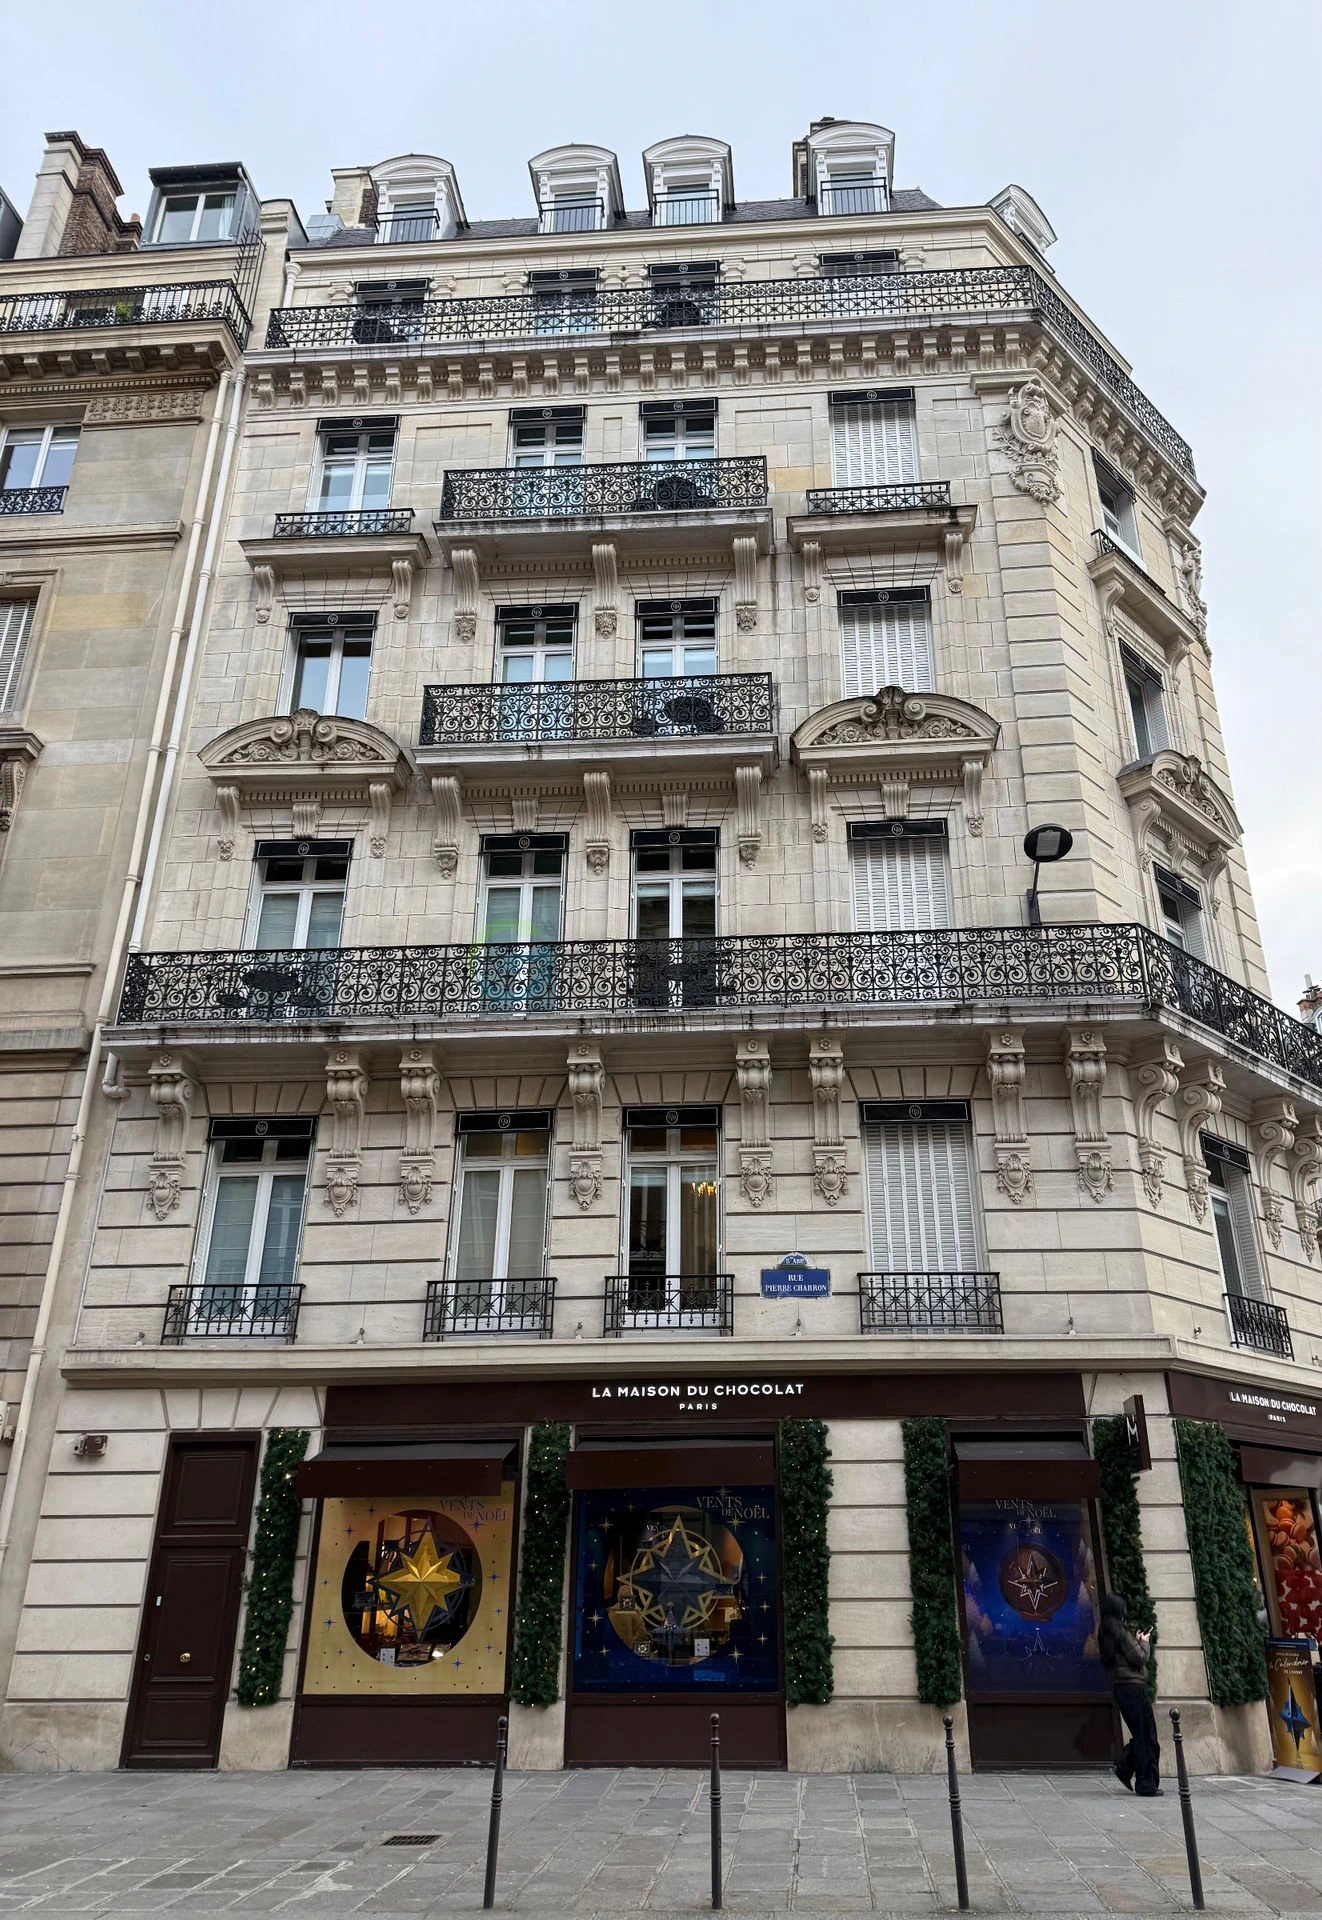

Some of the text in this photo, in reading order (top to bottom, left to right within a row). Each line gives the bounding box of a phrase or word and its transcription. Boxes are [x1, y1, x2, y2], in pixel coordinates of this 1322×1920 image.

[765, 1284, 827, 1292] PIERRE CHARRON
[592, 1384, 804, 1398] LA MAISON DU CHOCOLAT
[1229, 1391, 1317, 1416] LA MAISON DU CHOCOLAT
[1267, 1414, 1287, 1423] PARIS
[440, 1500, 484, 1511] VENTS
[696, 1496, 743, 1508] VENTS
[995, 1499, 1034, 1509] VENTS
[478, 1508, 509, 1520] NOËL
[721, 1504, 770, 1519] DE NOËL
[1027, 1506, 1056, 1518] NOËL
